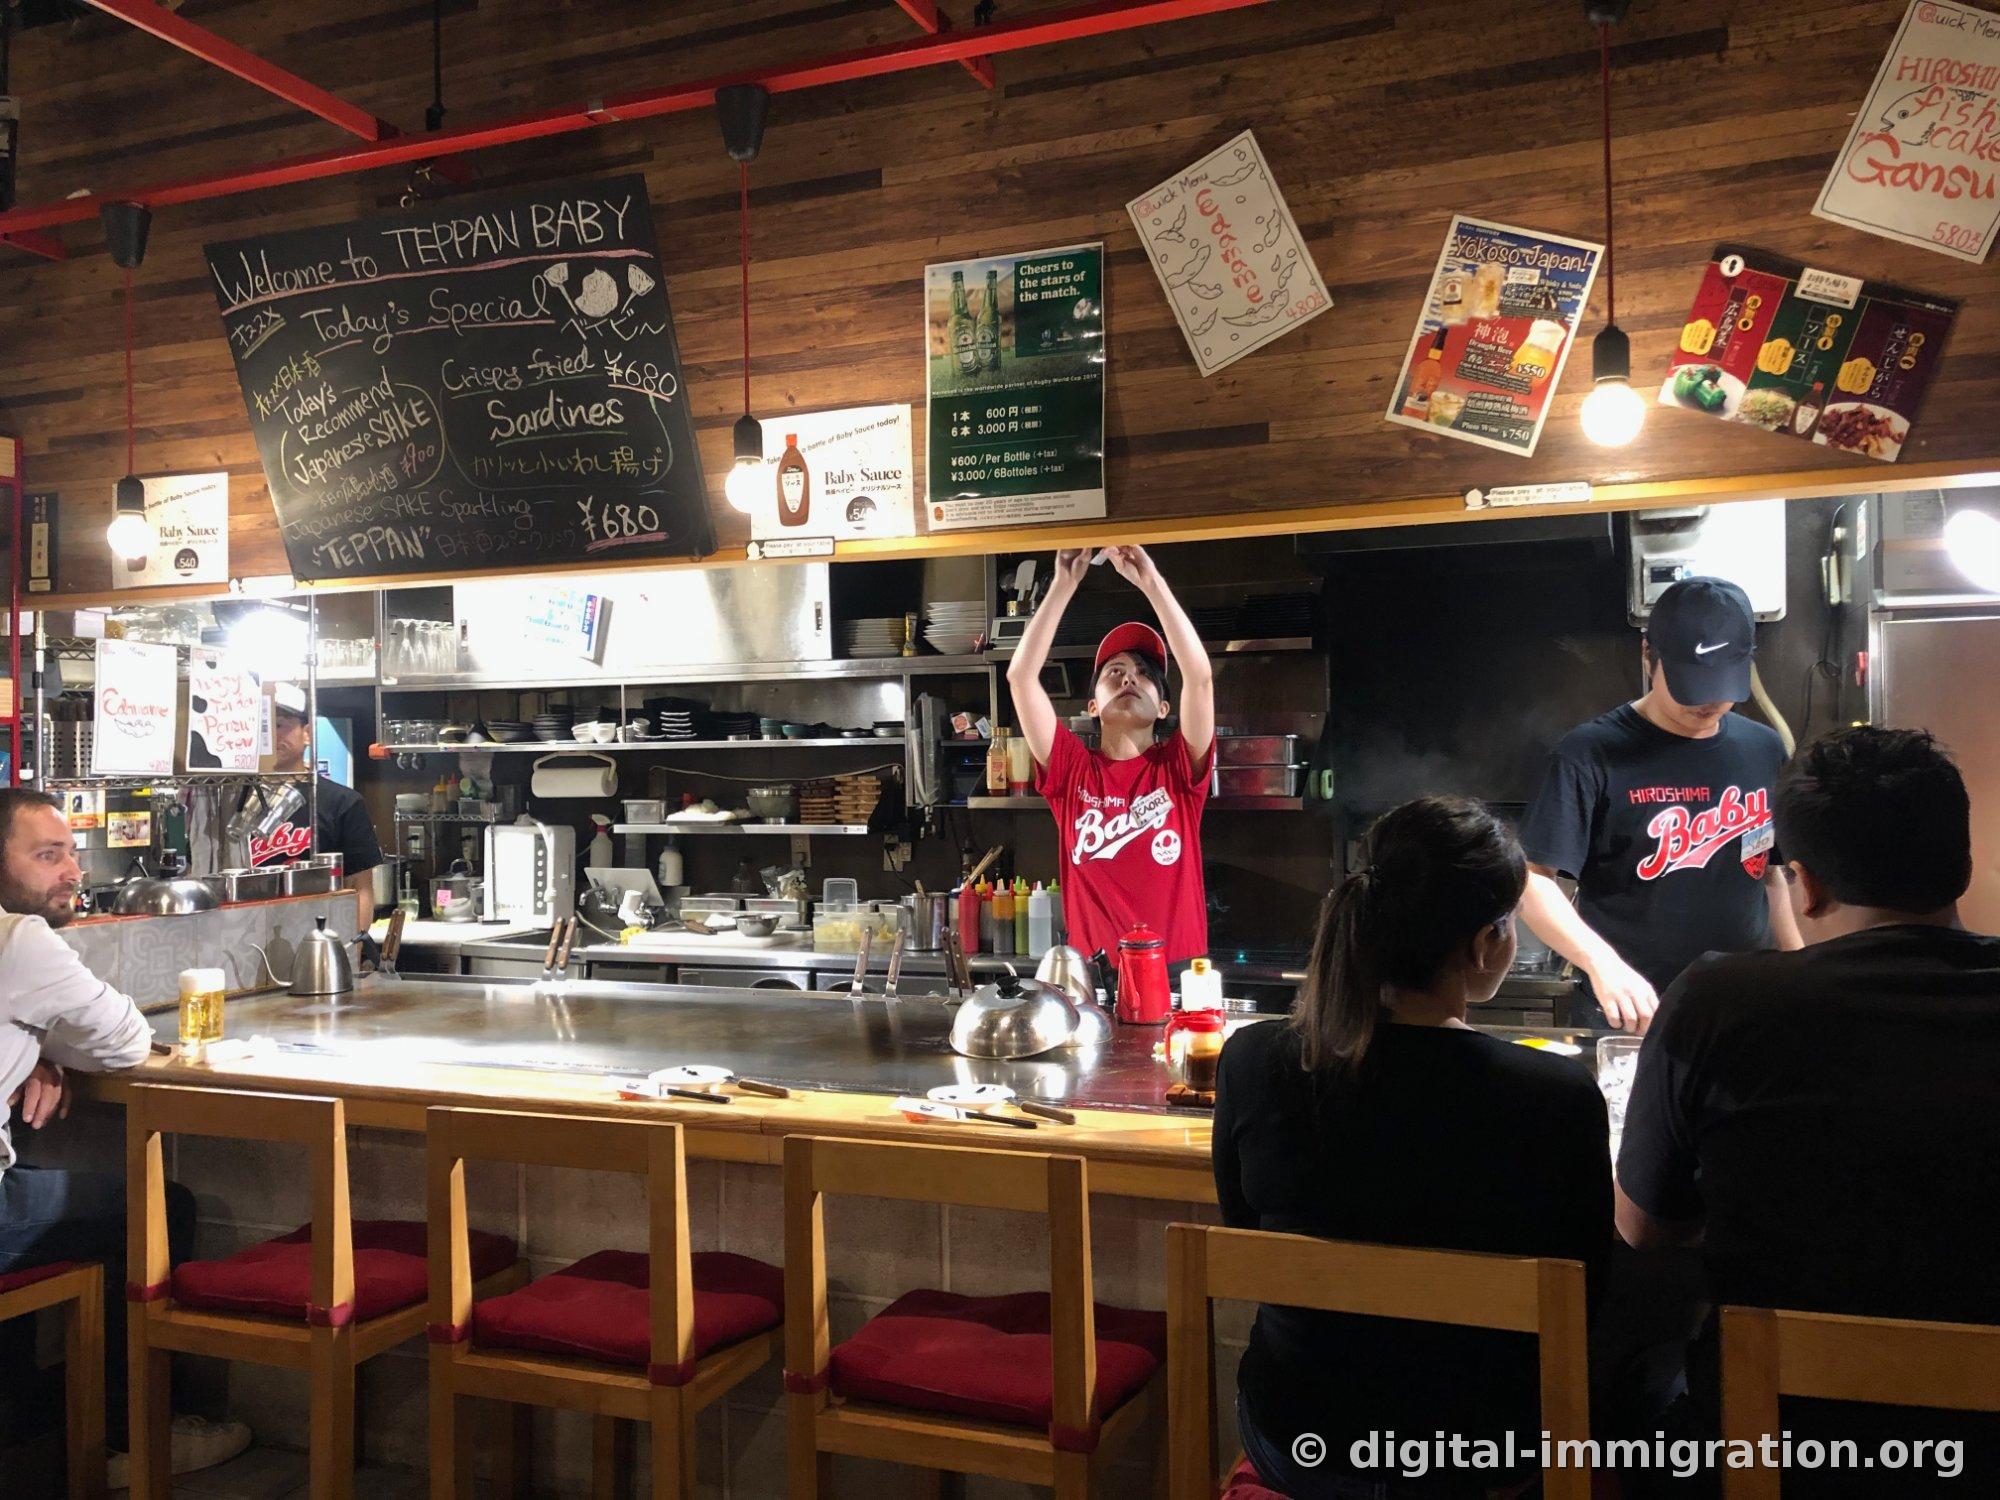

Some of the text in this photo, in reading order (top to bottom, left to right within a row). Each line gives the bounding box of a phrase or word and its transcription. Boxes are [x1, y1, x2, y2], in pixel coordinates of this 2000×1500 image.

[1918, 5, 2000, 40] Quick Men
[1911, 85, 1998, 132] fish
[1929, 125, 2000, 163] cake
[1136, 172, 1209, 218] Quick Menu
[211, 195, 631, 305] Welcome to TEPPAN BABY
[1019, 260, 1074, 276] Cheers to
[1525, 244, 1591, 276] Japan!
[1019, 271, 1086, 289] the stars of
[1019, 286, 1080, 303] the match.
[1807, 273, 1849, 289] お持ち帰り
[301, 275, 550, 354] Today's Special
[1794, 324, 1819, 364] ソース
[442, 344, 678, 396] Crispy fried ¥680
[1517, 363, 1546, 378] ¥550
[1871, 327, 1908, 399] せんじがら
[274, 381, 337, 425] Today's
[974, 384, 1004, 392] worldwide
[1004, 382, 1025, 390] partner
[1034, 379, 1051, 387] Rugby
[299, 366, 395, 445] Recommend
[487, 390, 625, 441] Sardines
[294, 398, 431, 485] Japanese SAKE
[766, 455, 782, 465] Take
[807, 439, 826, 451] bottle
[827, 436, 835, 445] of
[836, 430, 854, 442] Baby
[854, 423, 875, 435] Sauce
[876, 415, 900, 429] today!
[1502, 428, 1530, 441] ¥750
[825, 467, 902, 486] Baby Sauce
[951, 455, 977, 467] ¥600
[985, 453, 1001, 464] Per
[1003, 450, 1031, 462] Bottle
[170, 494, 183, 503] Baby
[860, 483, 902, 492] オリジナルソース
[159, 524, 219, 541] Baby Sauce
[284, 488, 533, 541] Japanese SAKE Sparkling
[578, 495, 659, 540] ¥680
[1135, 794, 1168, 819] KAORI
[1629, 786, 1711, 805] HIROSHIMA
[249, 821, 312, 857] aby
[1636, 785, 1773, 881] Baby
